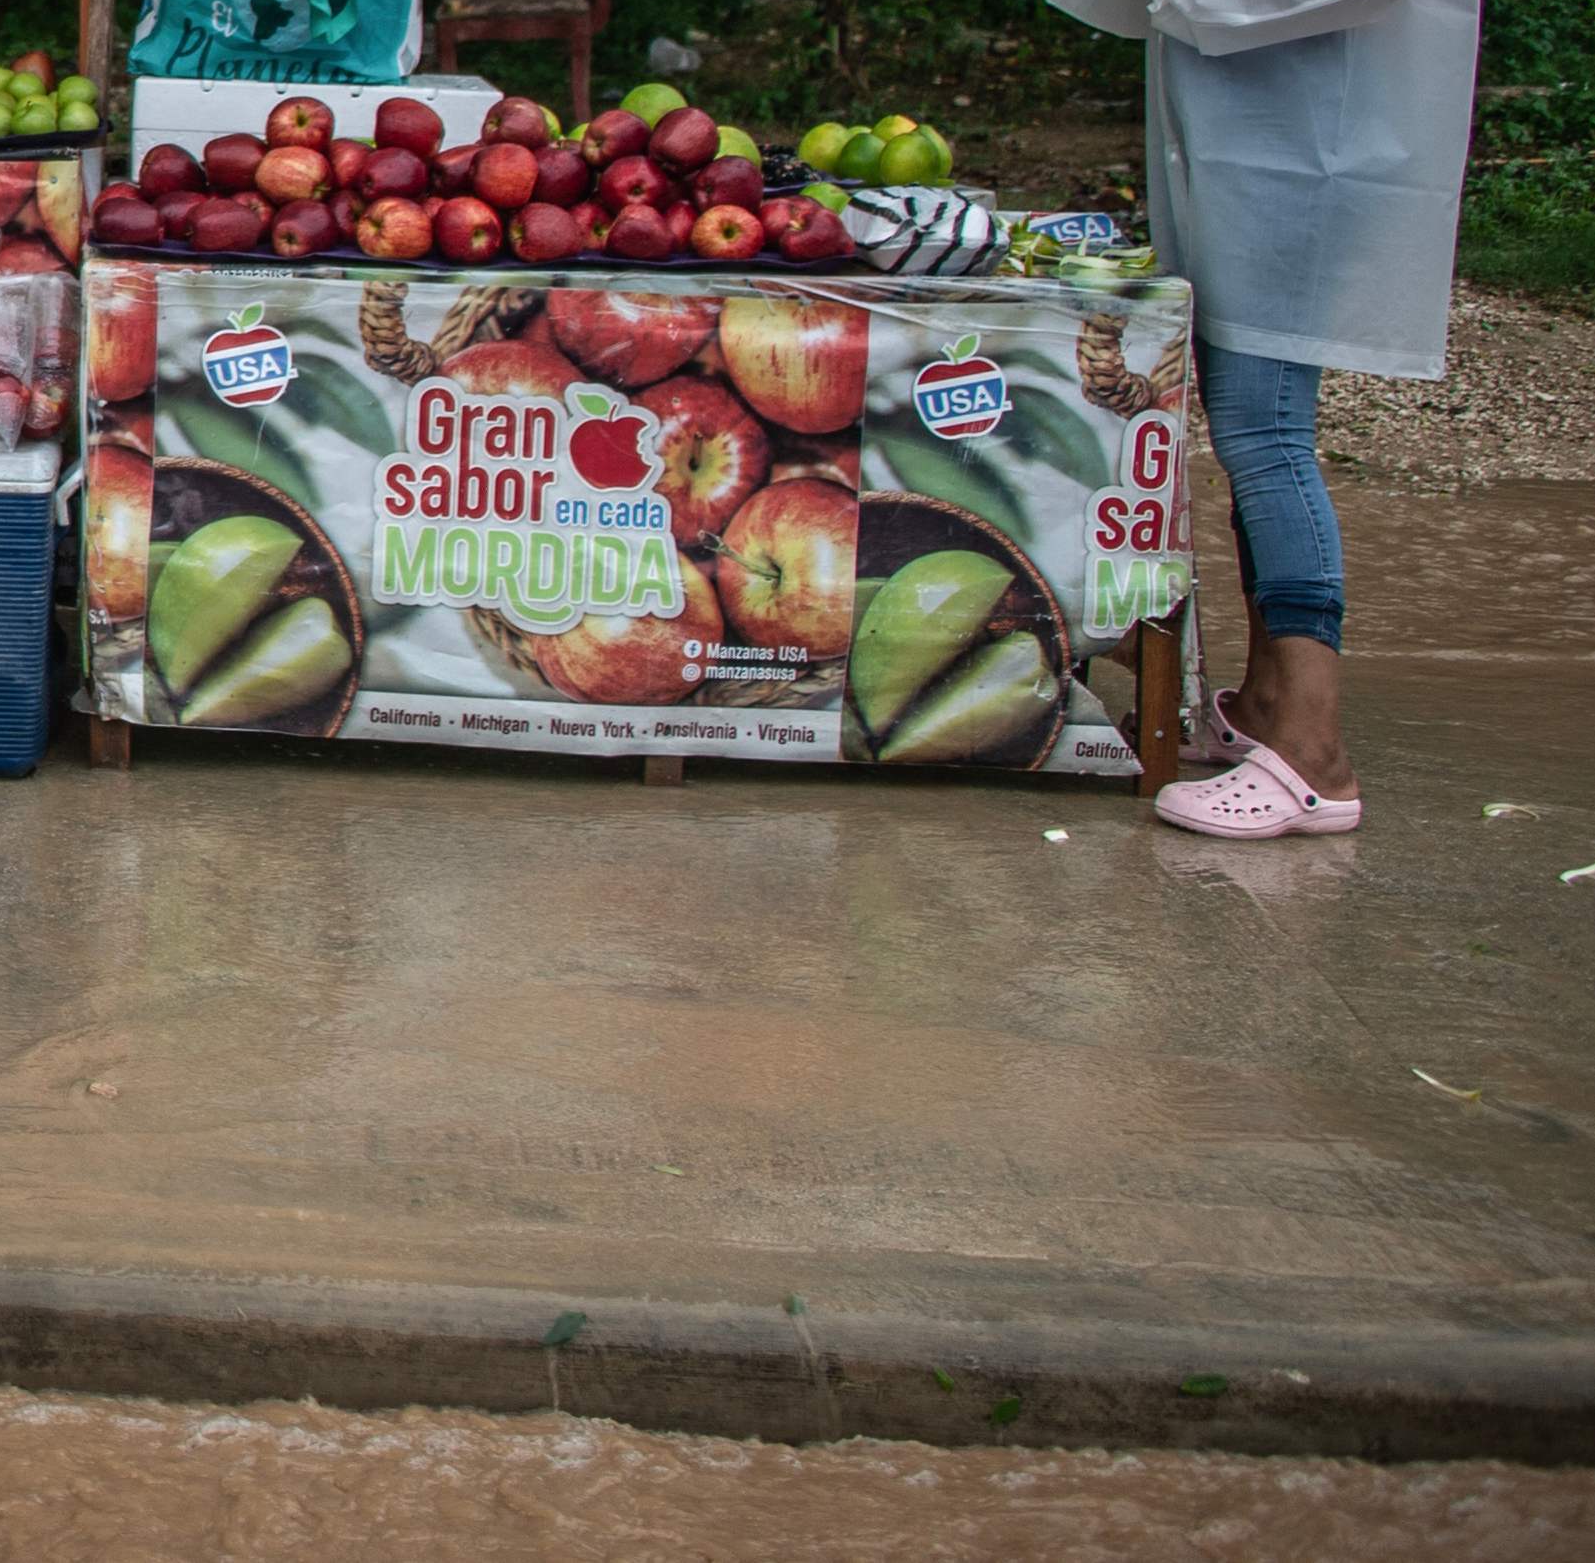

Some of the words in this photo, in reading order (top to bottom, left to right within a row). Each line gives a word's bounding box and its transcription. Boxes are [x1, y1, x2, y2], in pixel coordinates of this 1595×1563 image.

[215, 353, 282, 386] USA
[925, 384, 996, 417] USA
[417, 387, 556, 460] Gran
[384, 463, 555, 522] sabor
[556, 499, 588, 524] en
[598, 496, 664, 529] cada
[382, 525, 675, 623] MORDIDA
[706, 642, 775, 661] Manzanas
[778, 646, 808, 662] USA
[705, 665, 796, 681] manzanasusa
[370, 706, 442, 728] California
[461, 713, 530, 735] Michigan
[550, 718, 596, 738] Nueva
[601, 720, 635, 739] York
[758, 723, 816, 744] Virginia
